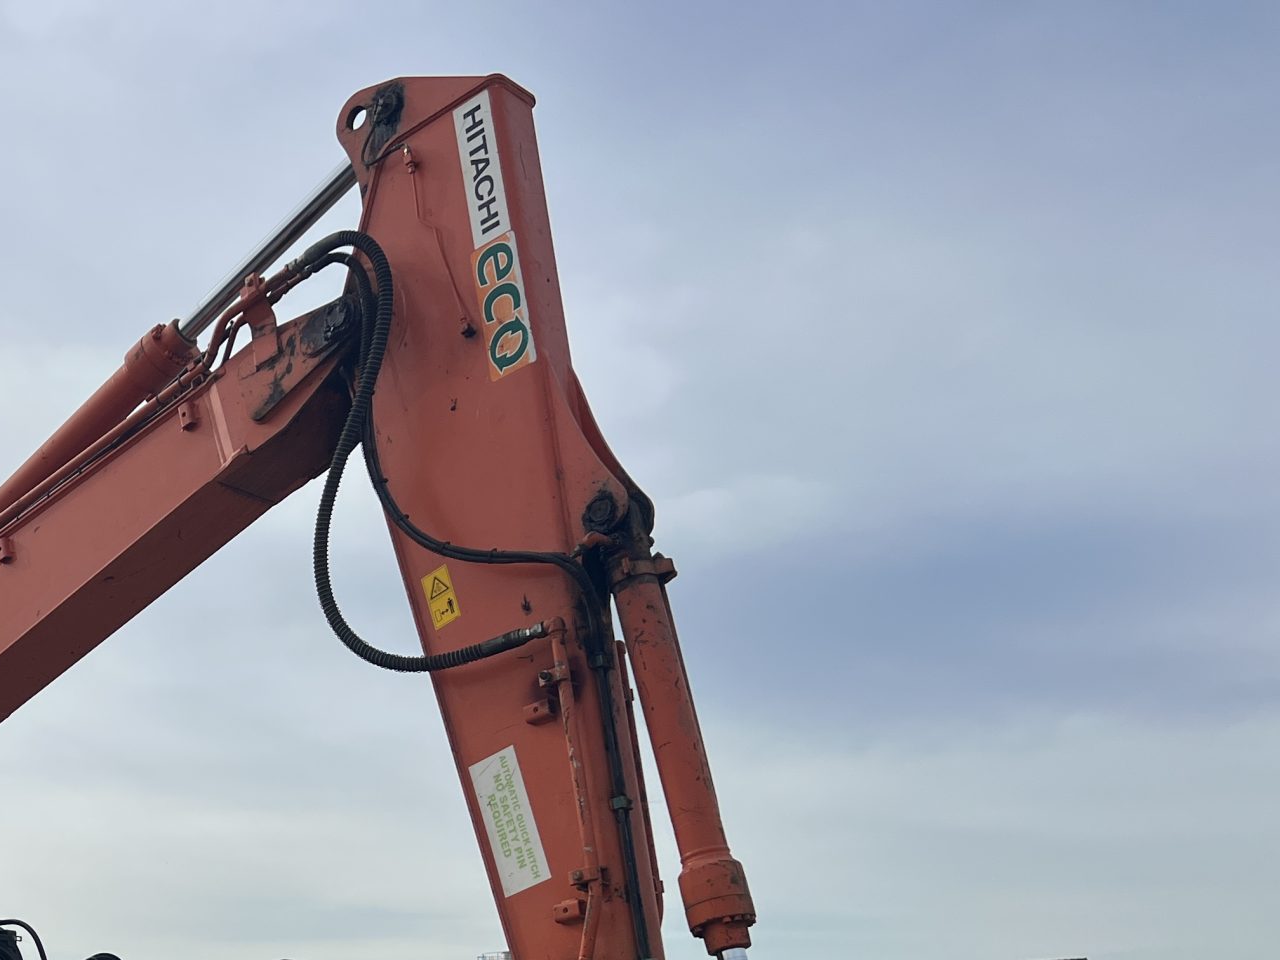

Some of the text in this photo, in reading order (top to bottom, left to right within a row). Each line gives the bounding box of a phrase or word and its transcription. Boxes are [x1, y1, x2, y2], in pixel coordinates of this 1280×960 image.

[463, 103, 500, 235] HITACHI
[487, 793, 512, 858] REQUIRED
[493, 773, 528, 869] NO SAFETY PIN
[498, 755, 541, 879] AUTOMATIC QUICK HITCH
